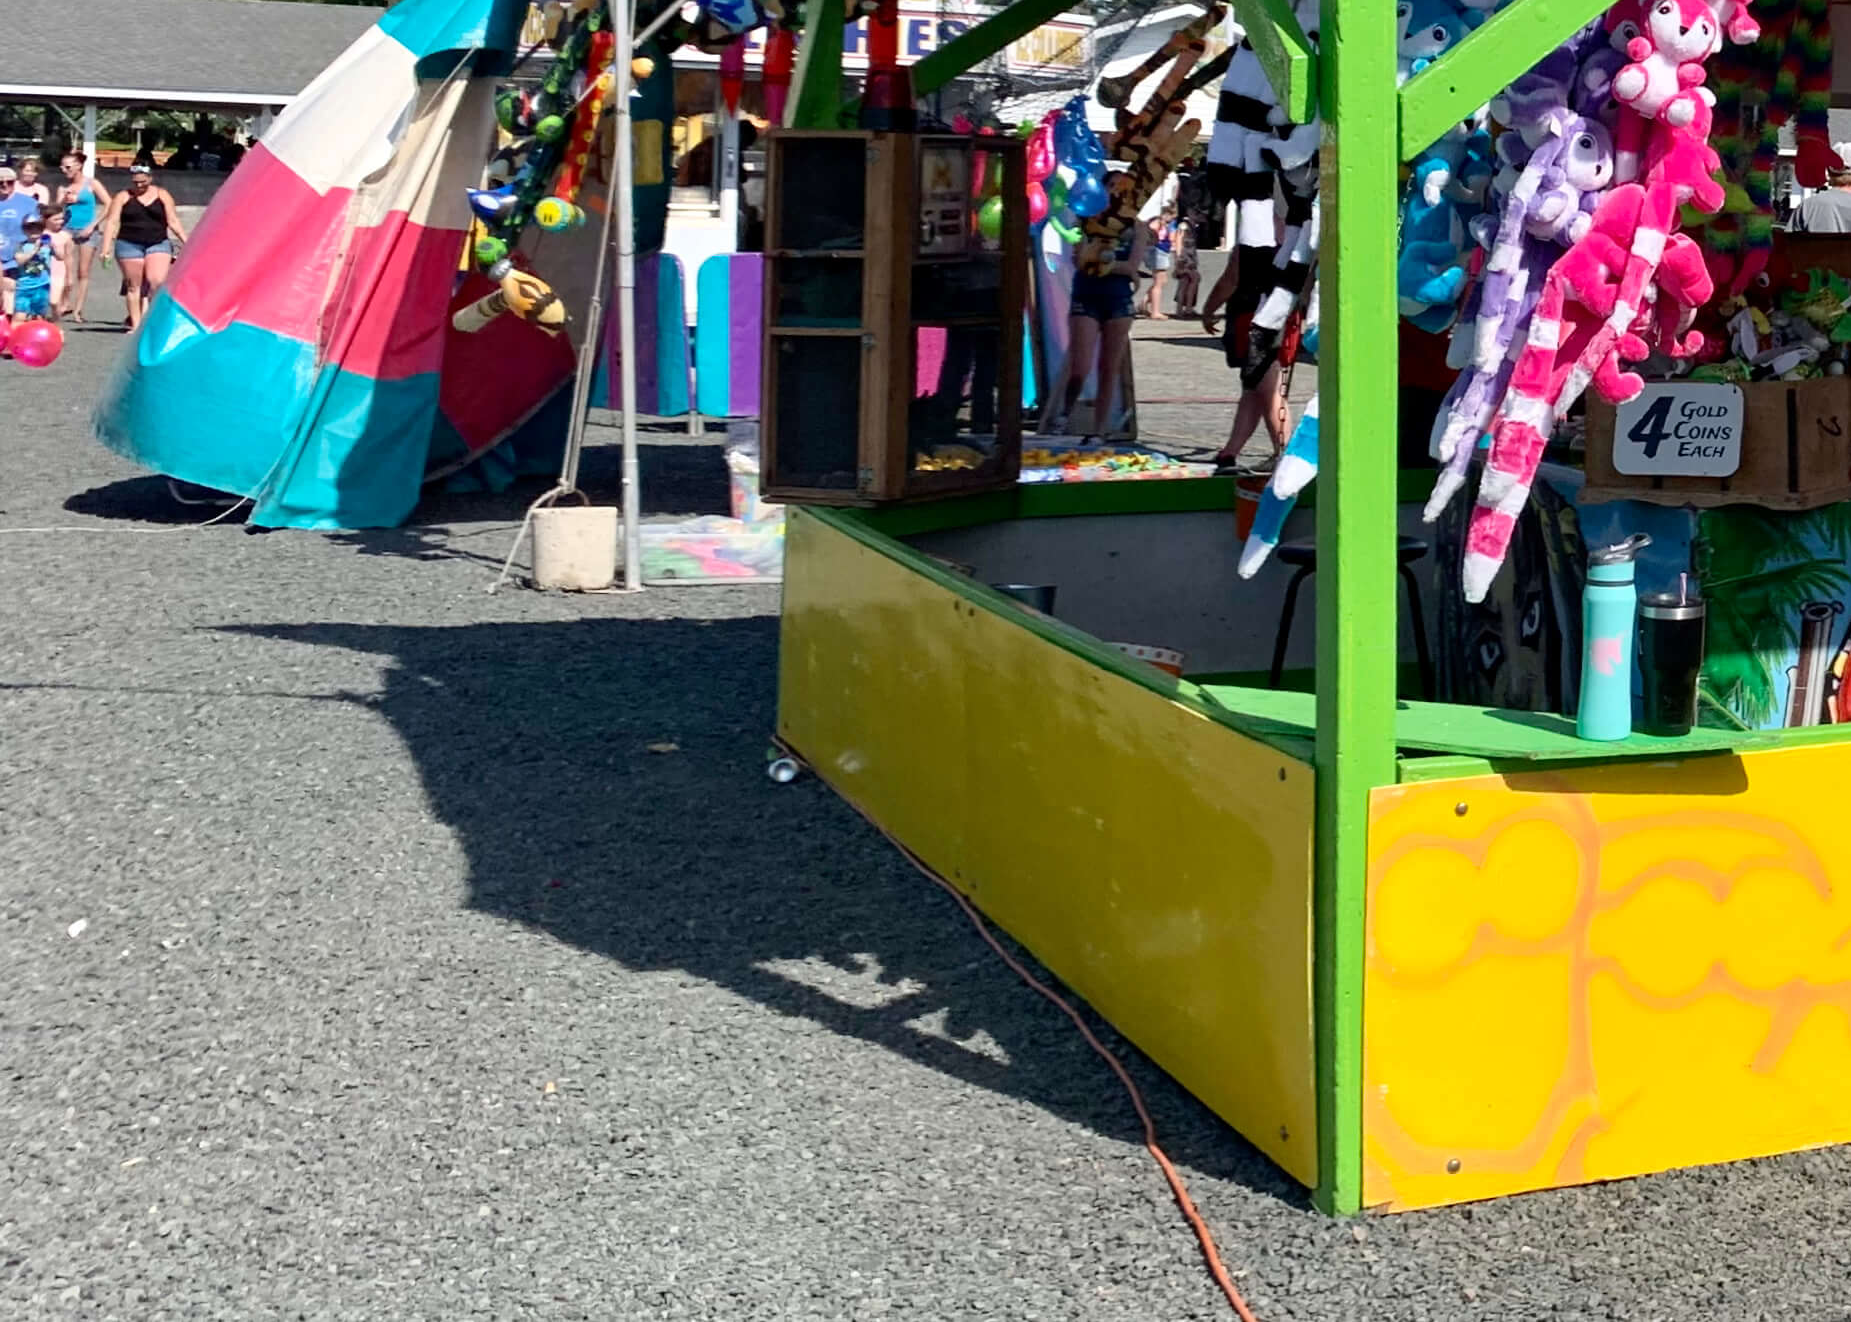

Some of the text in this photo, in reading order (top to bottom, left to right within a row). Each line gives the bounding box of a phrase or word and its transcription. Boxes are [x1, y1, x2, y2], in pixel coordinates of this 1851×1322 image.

[1680, 401, 1728, 419] GOLD
[1627, 396, 1676, 459] 4
[1673, 420, 1733, 440] COINS
[1678, 442, 1725, 458] EACH
